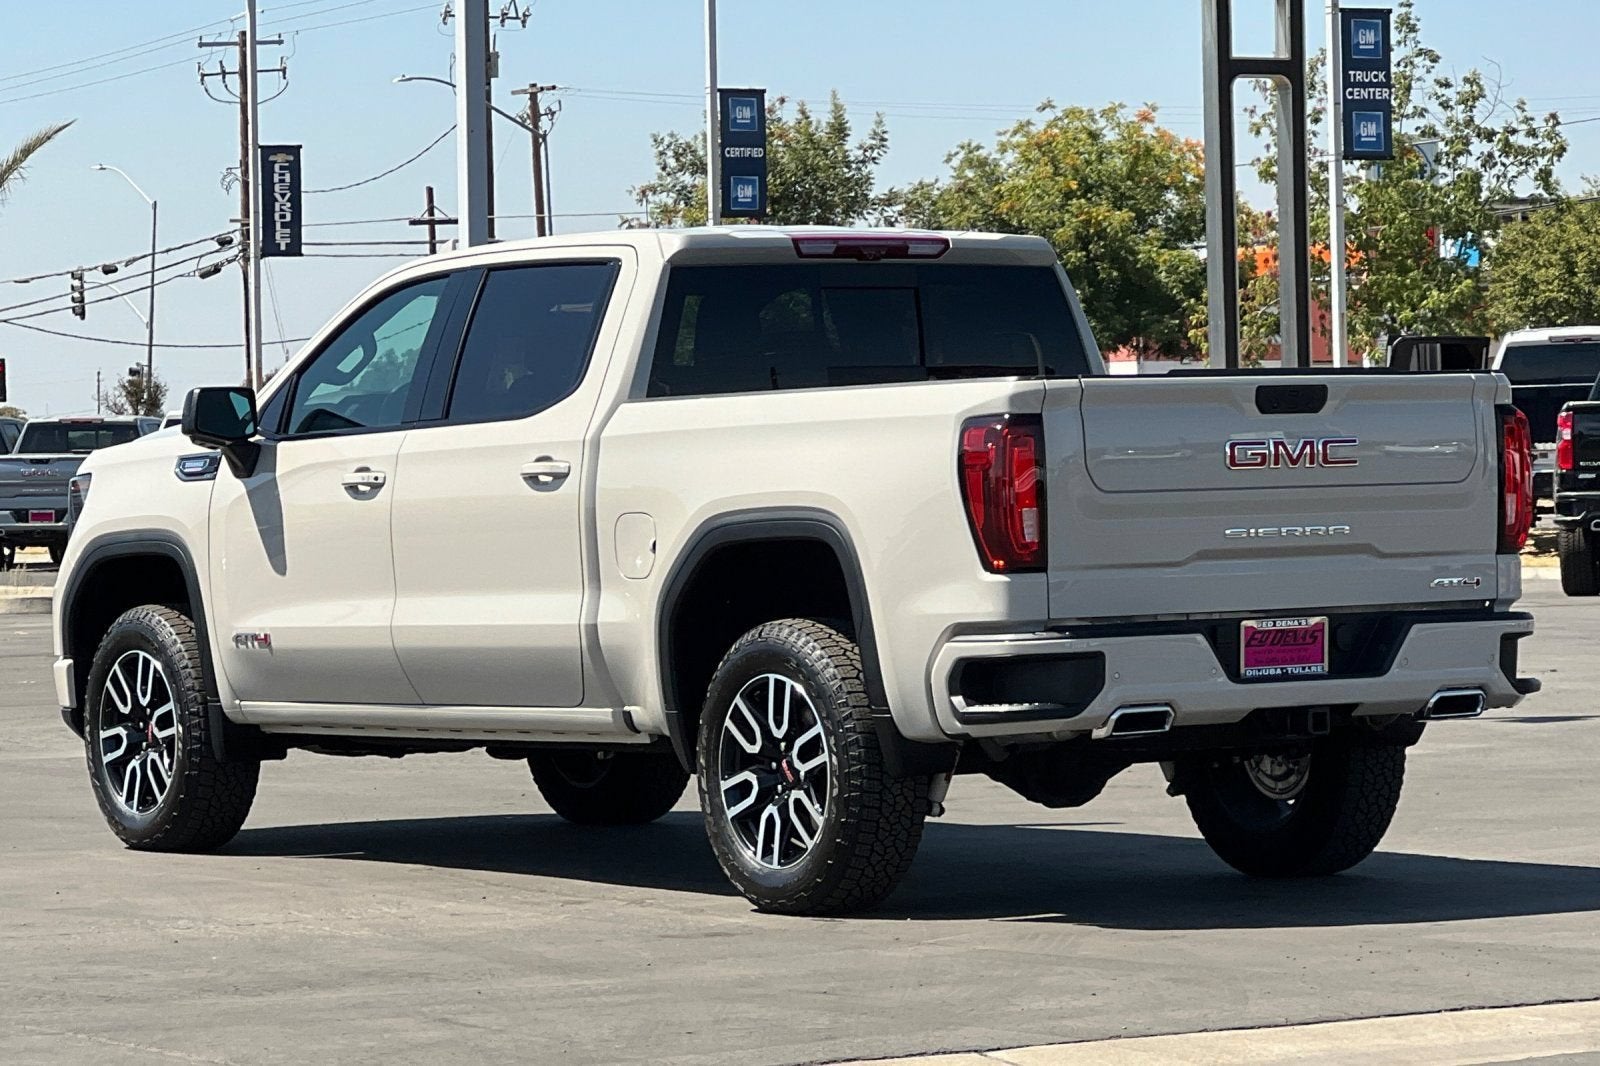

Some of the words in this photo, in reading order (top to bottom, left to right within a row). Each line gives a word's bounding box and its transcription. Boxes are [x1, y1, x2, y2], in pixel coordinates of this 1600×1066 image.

[1358, 28, 1375, 45] GM
[1348, 70, 1387, 83] TRUCK
[1345, 87, 1390, 100] CENTER
[736, 105, 751, 119] GM
[1360, 121, 1377, 137] GM
[724, 147, 764, 158] CERTIFIED
[737, 184, 752, 198] GM
[273, 162, 293, 251] CHEVROLET
[1225, 437, 1359, 470] GMC
[1224, 525, 1351, 538] SIERRA
[1430, 576, 1481, 589] AT4
